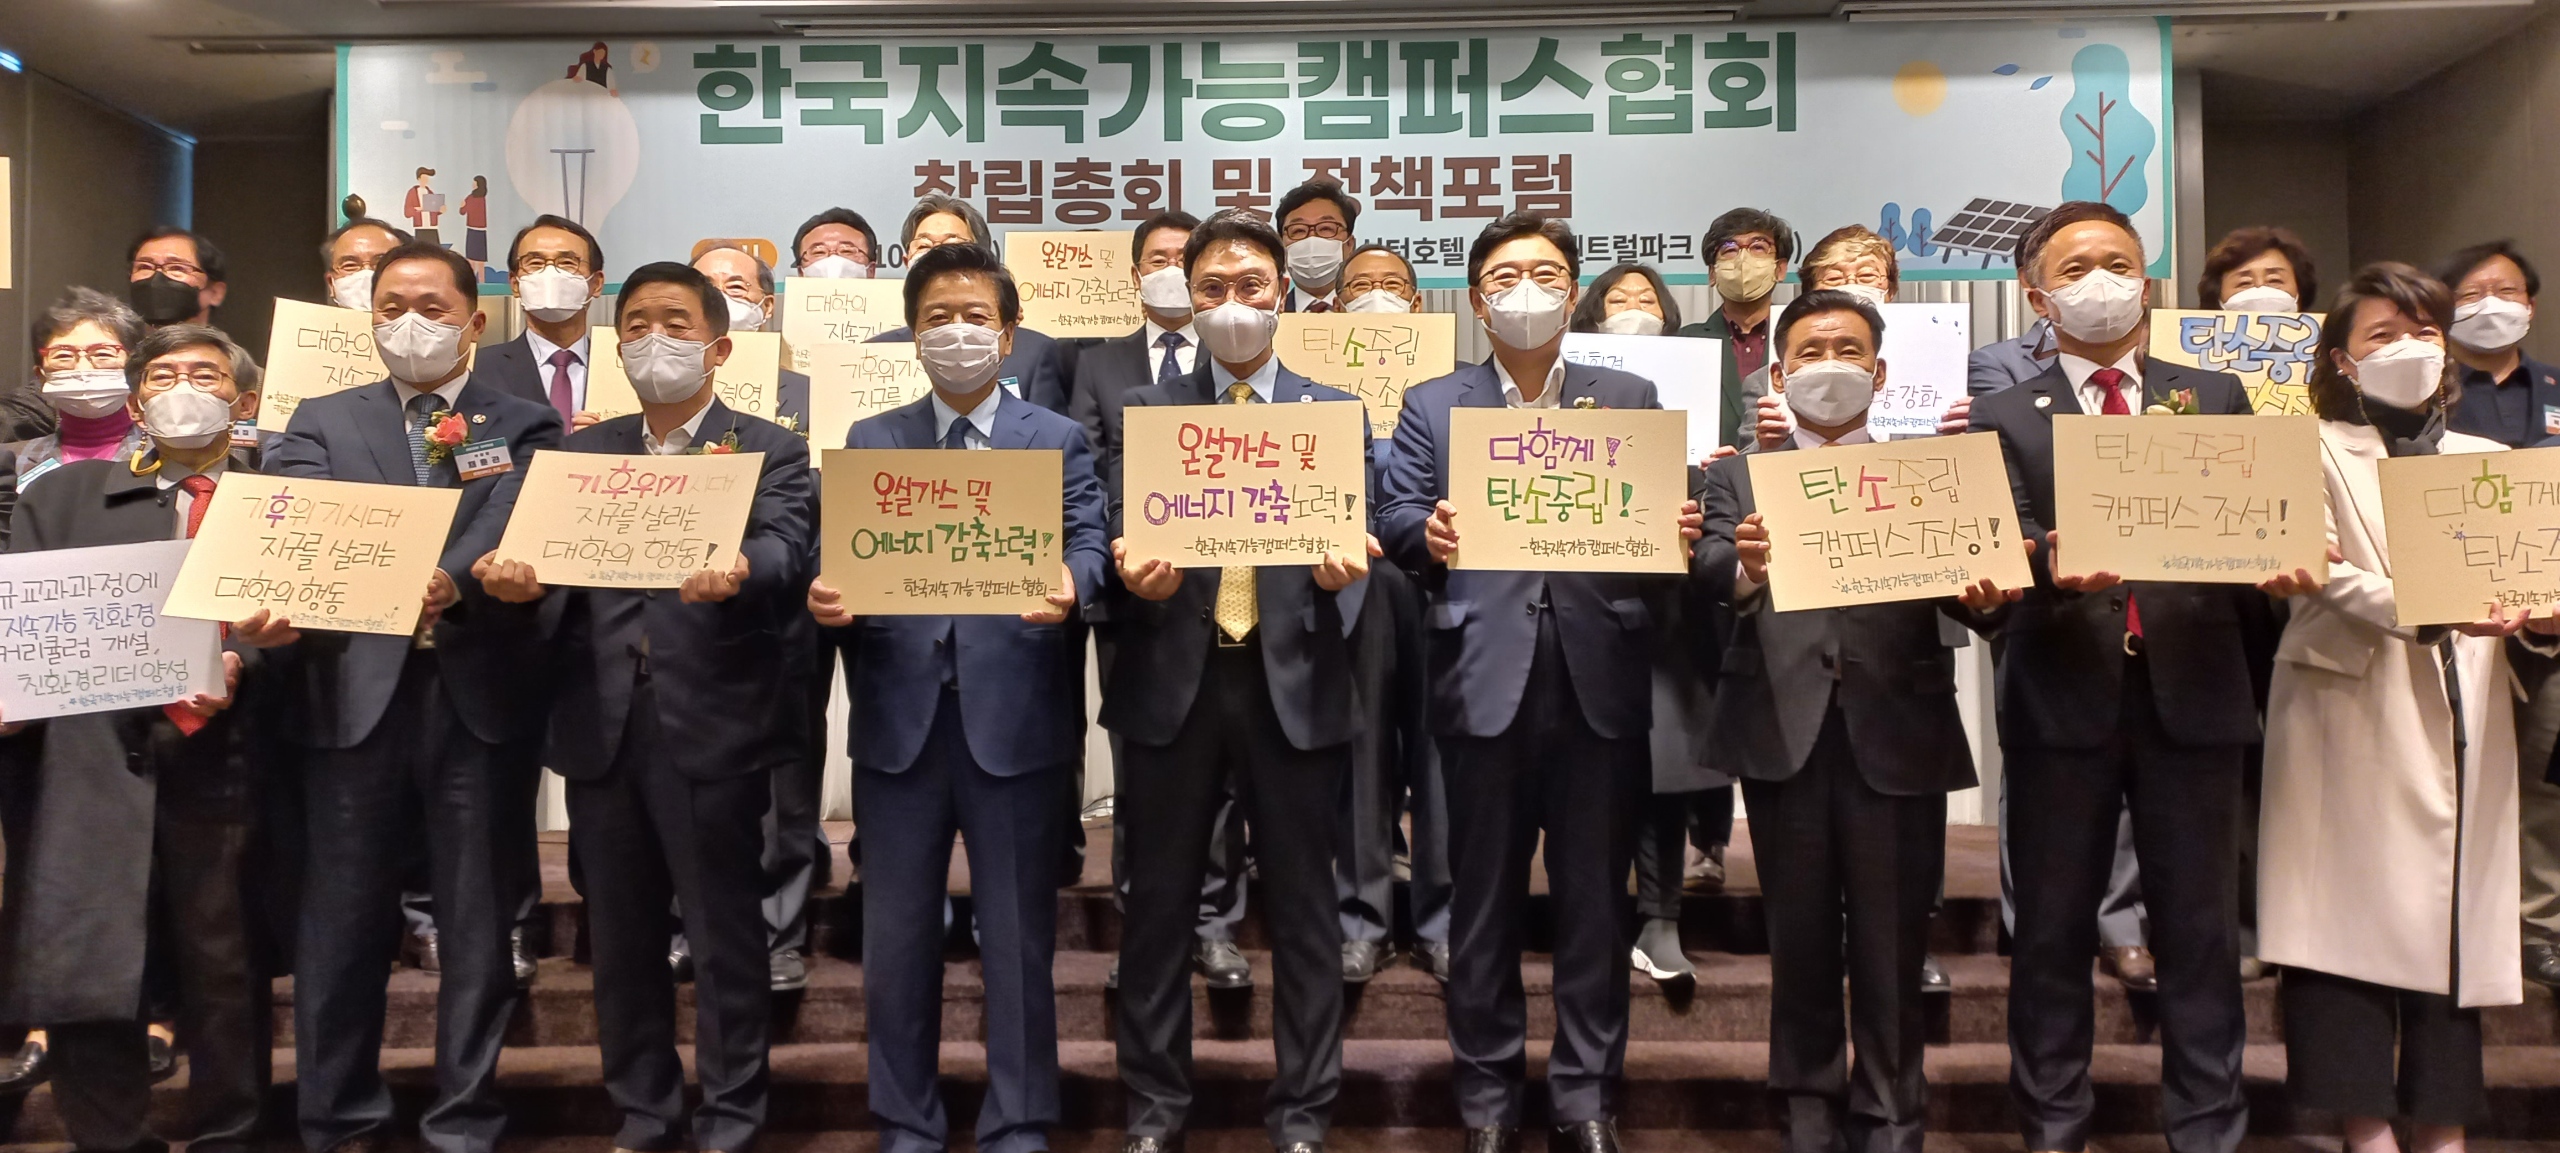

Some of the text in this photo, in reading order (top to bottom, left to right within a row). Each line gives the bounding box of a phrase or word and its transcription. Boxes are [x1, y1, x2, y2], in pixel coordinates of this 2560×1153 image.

[692, 32, 1798, 146] 한국지속가능캠퍼스협회
[911, 153, 1574, 225] 창립총회 및 정책포럼
[1042, 241, 1115, 270] 온실가스 및
[806, 289, 867, 315] 대학의
[1018, 281, 1070, 302] 에너지
[298, 323, 373, 361] 대학의
[1303, 325, 1420, 369] 탄소중립
[1178, 423, 1317, 479] 온실가스 및
[2095, 432, 2257, 479] 탄소중립
[873, 471, 992, 517] 온실가스 및
[1799, 456, 1961, 514] 탄소중립
[242, 486, 404, 528] 기후위기시대
[576, 502, 701, 535] 지구를 살리는
[1144, 491, 1234, 526] 에너지
[260, 531, 397, 571] 지구를 살리는
[542, 536, 634, 567] 대학의
[851, 528, 933, 560] 에너지
[215, 570, 348, 615] 대학의 행동
[0, 602, 156, 640] 지속가능 친환경
[0, 635, 91, 666] 커리큘럼
